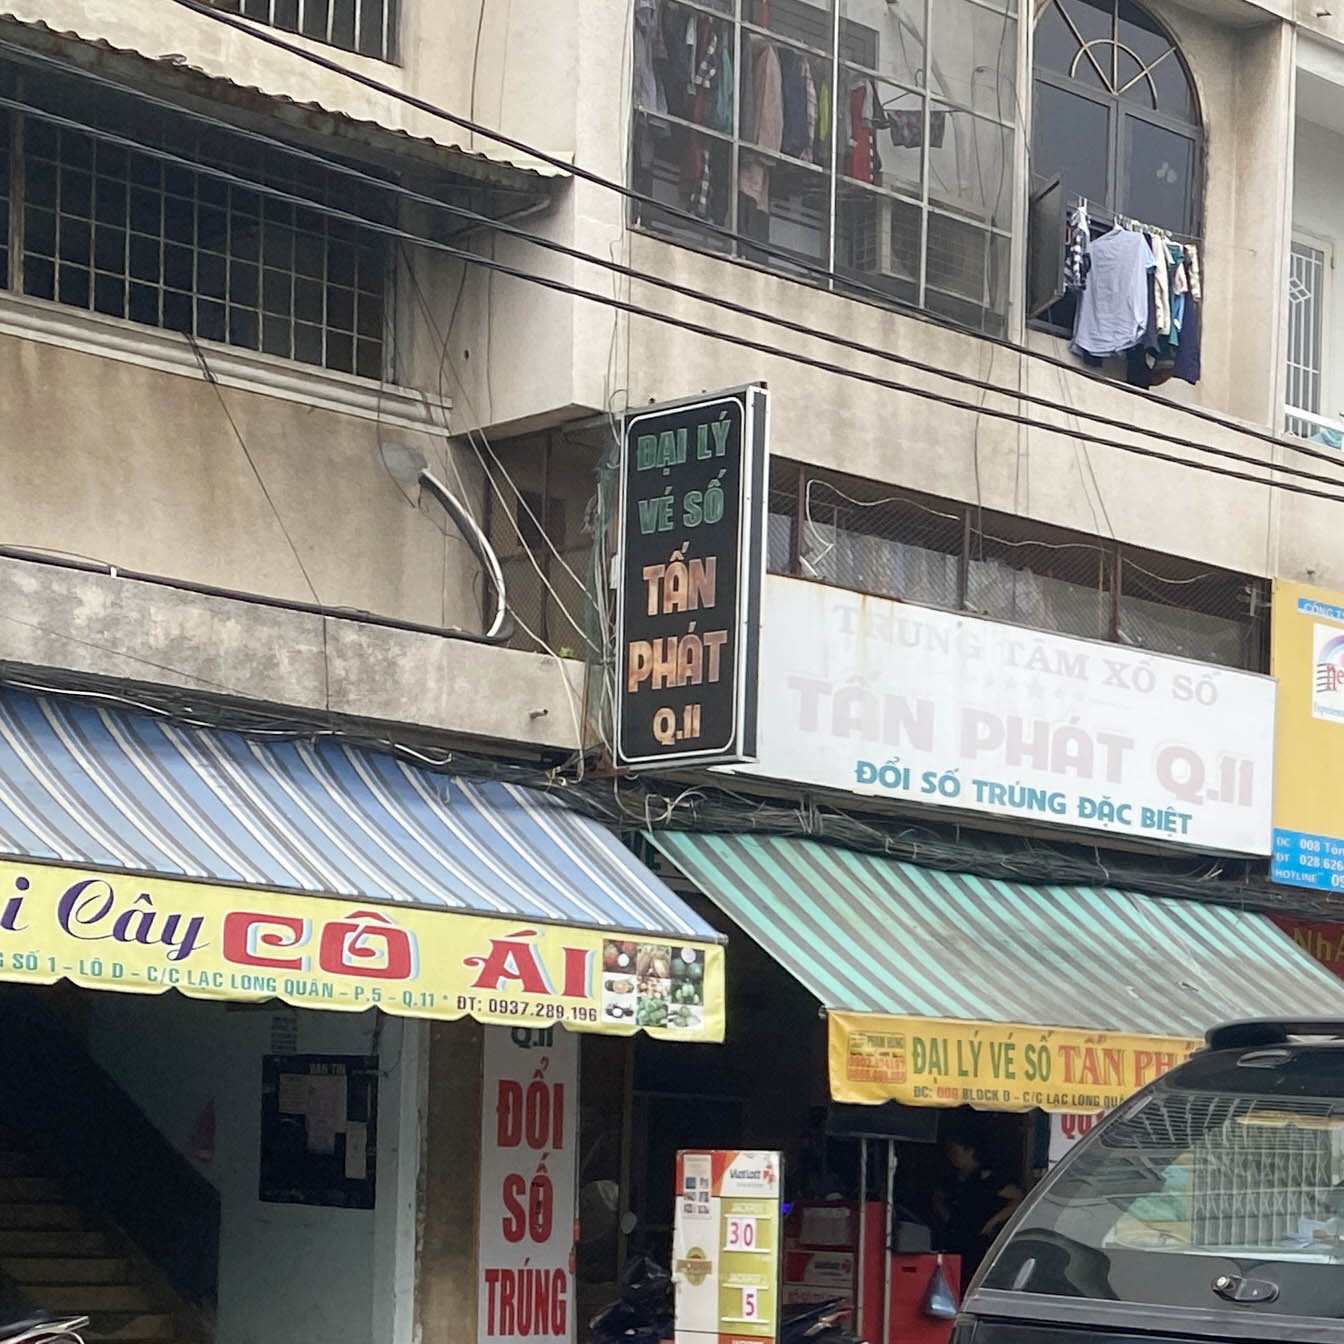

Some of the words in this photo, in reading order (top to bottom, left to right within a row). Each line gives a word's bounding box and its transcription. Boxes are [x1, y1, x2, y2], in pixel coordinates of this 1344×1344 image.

[636, 428, 688, 476] ĐẠI
[697, 411, 732, 460] LÝ
[638, 486, 675, 534] VÉ
[683, 469, 727, 528] SỐ
[643, 541, 717, 615] TẤN
[628, 621, 728, 693] PHÁT
[833, 603, 982, 662] TRUNG
[1003, 637, 1089, 682] TÂM
[1172, 670, 1222, 706] SỐ
[788, 668, 936, 753] TẤN
[960, 716, 1135, 784] PHÁT
[854, 755, 911, 791] ĐỔI
[921, 767, 962, 798] SỐ
[972, 778, 1068, 816] TRÚNG
[1076, 795, 1133, 828] ĐẶC
[1141, 807, 1193, 839] BIỆT
[58, 879, 210, 961] Cây
[222, 910, 420, 981] CÔ
[463, 929, 597, 999] ÁI
[12, 950, 40, 971] SỐ
[48, 957, 56, 973] 1
[80, 956, 103, 977] LÔ
[112, 962, 124, 978] D
[147, 966, 180, 984] C/C
[188, 969, 224, 990] LẠC
[231, 975, 277, 993] LONG
[285, 978, 335, 998] QUÂN
[354, 988, 382, 1002] P.5
[402, 990, 435, 1008] Q.11
[488, 1000, 598, 1023] 0937.289.196
[912, 1036, 949, 1084] ĐẠI
[957, 1030, 982, 1078] LÝ
[990, 1032, 1016, 1080] VÉ
[1024, 1030, 1056, 1082] SỐ
[1058, 1034, 1128, 1087] TẤN
[496, 1056, 564, 1150] ĐỔI
[961, 1087, 999, 1102] BLOCK
[1071, 1095, 1100, 1107] LONG
[502, 1152, 553, 1243] SỐ
[729, 1221, 754, 1247] 30
[484, 1257, 567, 1336] TRÚNG
[745, 1293, 755, 1316] 5
